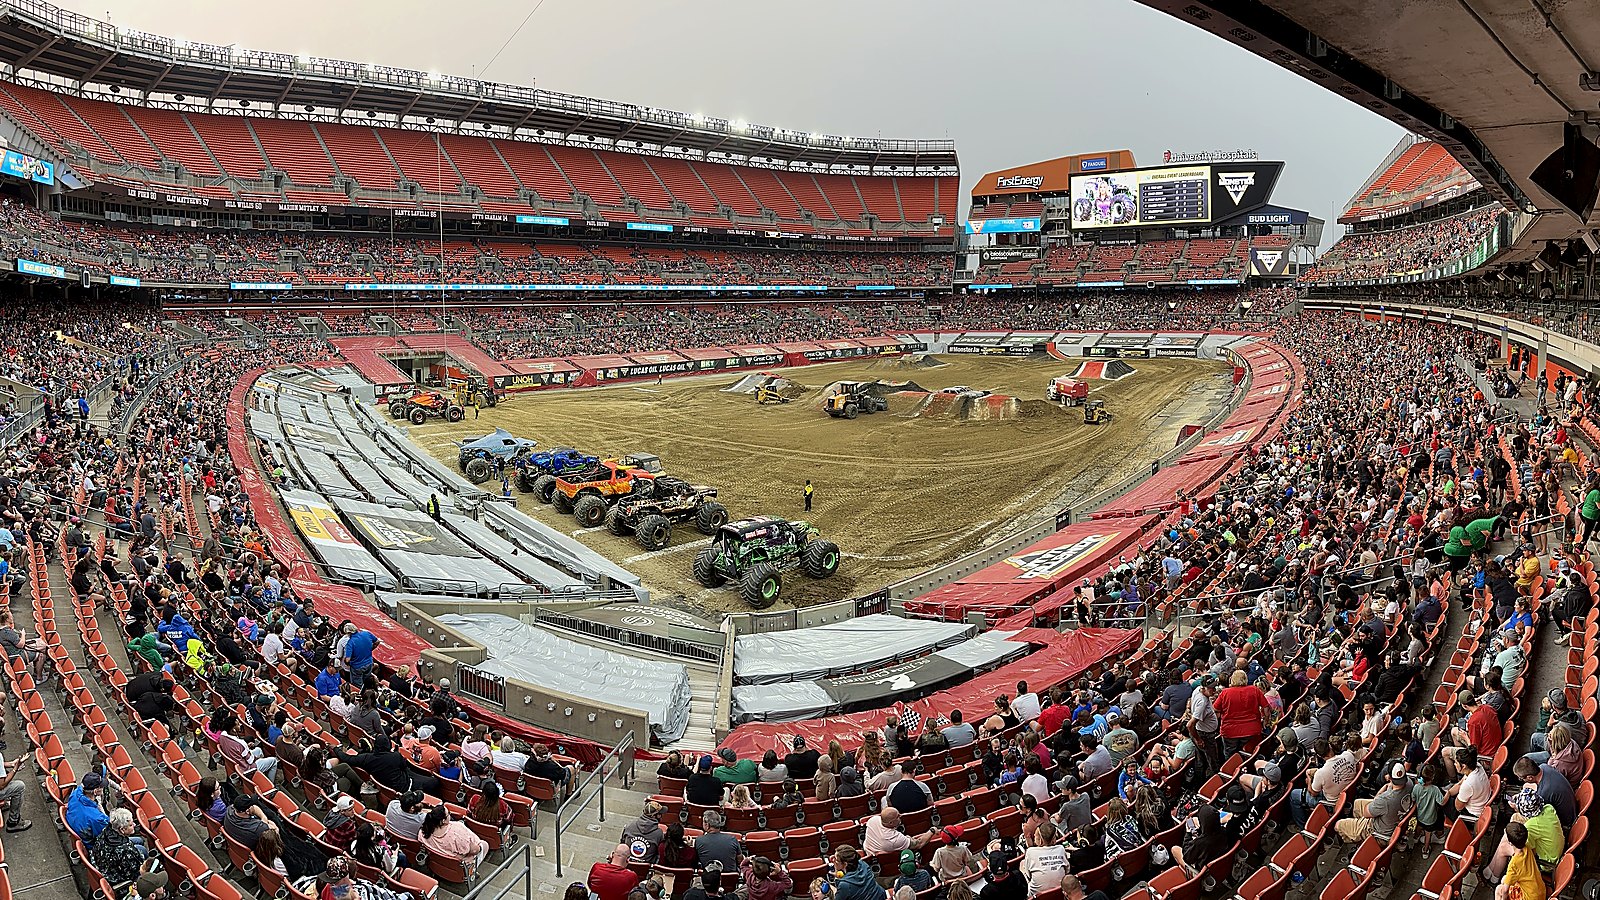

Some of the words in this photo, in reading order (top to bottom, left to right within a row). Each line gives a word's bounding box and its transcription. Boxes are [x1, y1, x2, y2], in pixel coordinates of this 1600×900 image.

[1171, 152, 1213, 163] University
[1214, 149, 1258, 161] Hospitals
[1087, 160, 1106, 168] FANDUEL
[996, 175, 1045, 188] FirstEnergy
[1248, 215, 1265, 223] BUD
[1266, 215, 1290, 223] LIGHT
[630, 366, 648, 375] LUCAS
[648, 365, 658, 373] OIL
[658, 364, 676, 373] LUCAS
[676, 363, 686, 371] OIL
[511, 375, 534, 385] UNOH
[890, 662, 916, 673] Jude
[831, 669, 889, 687] Children's
[1239, 805, 1259, 837] JUST
